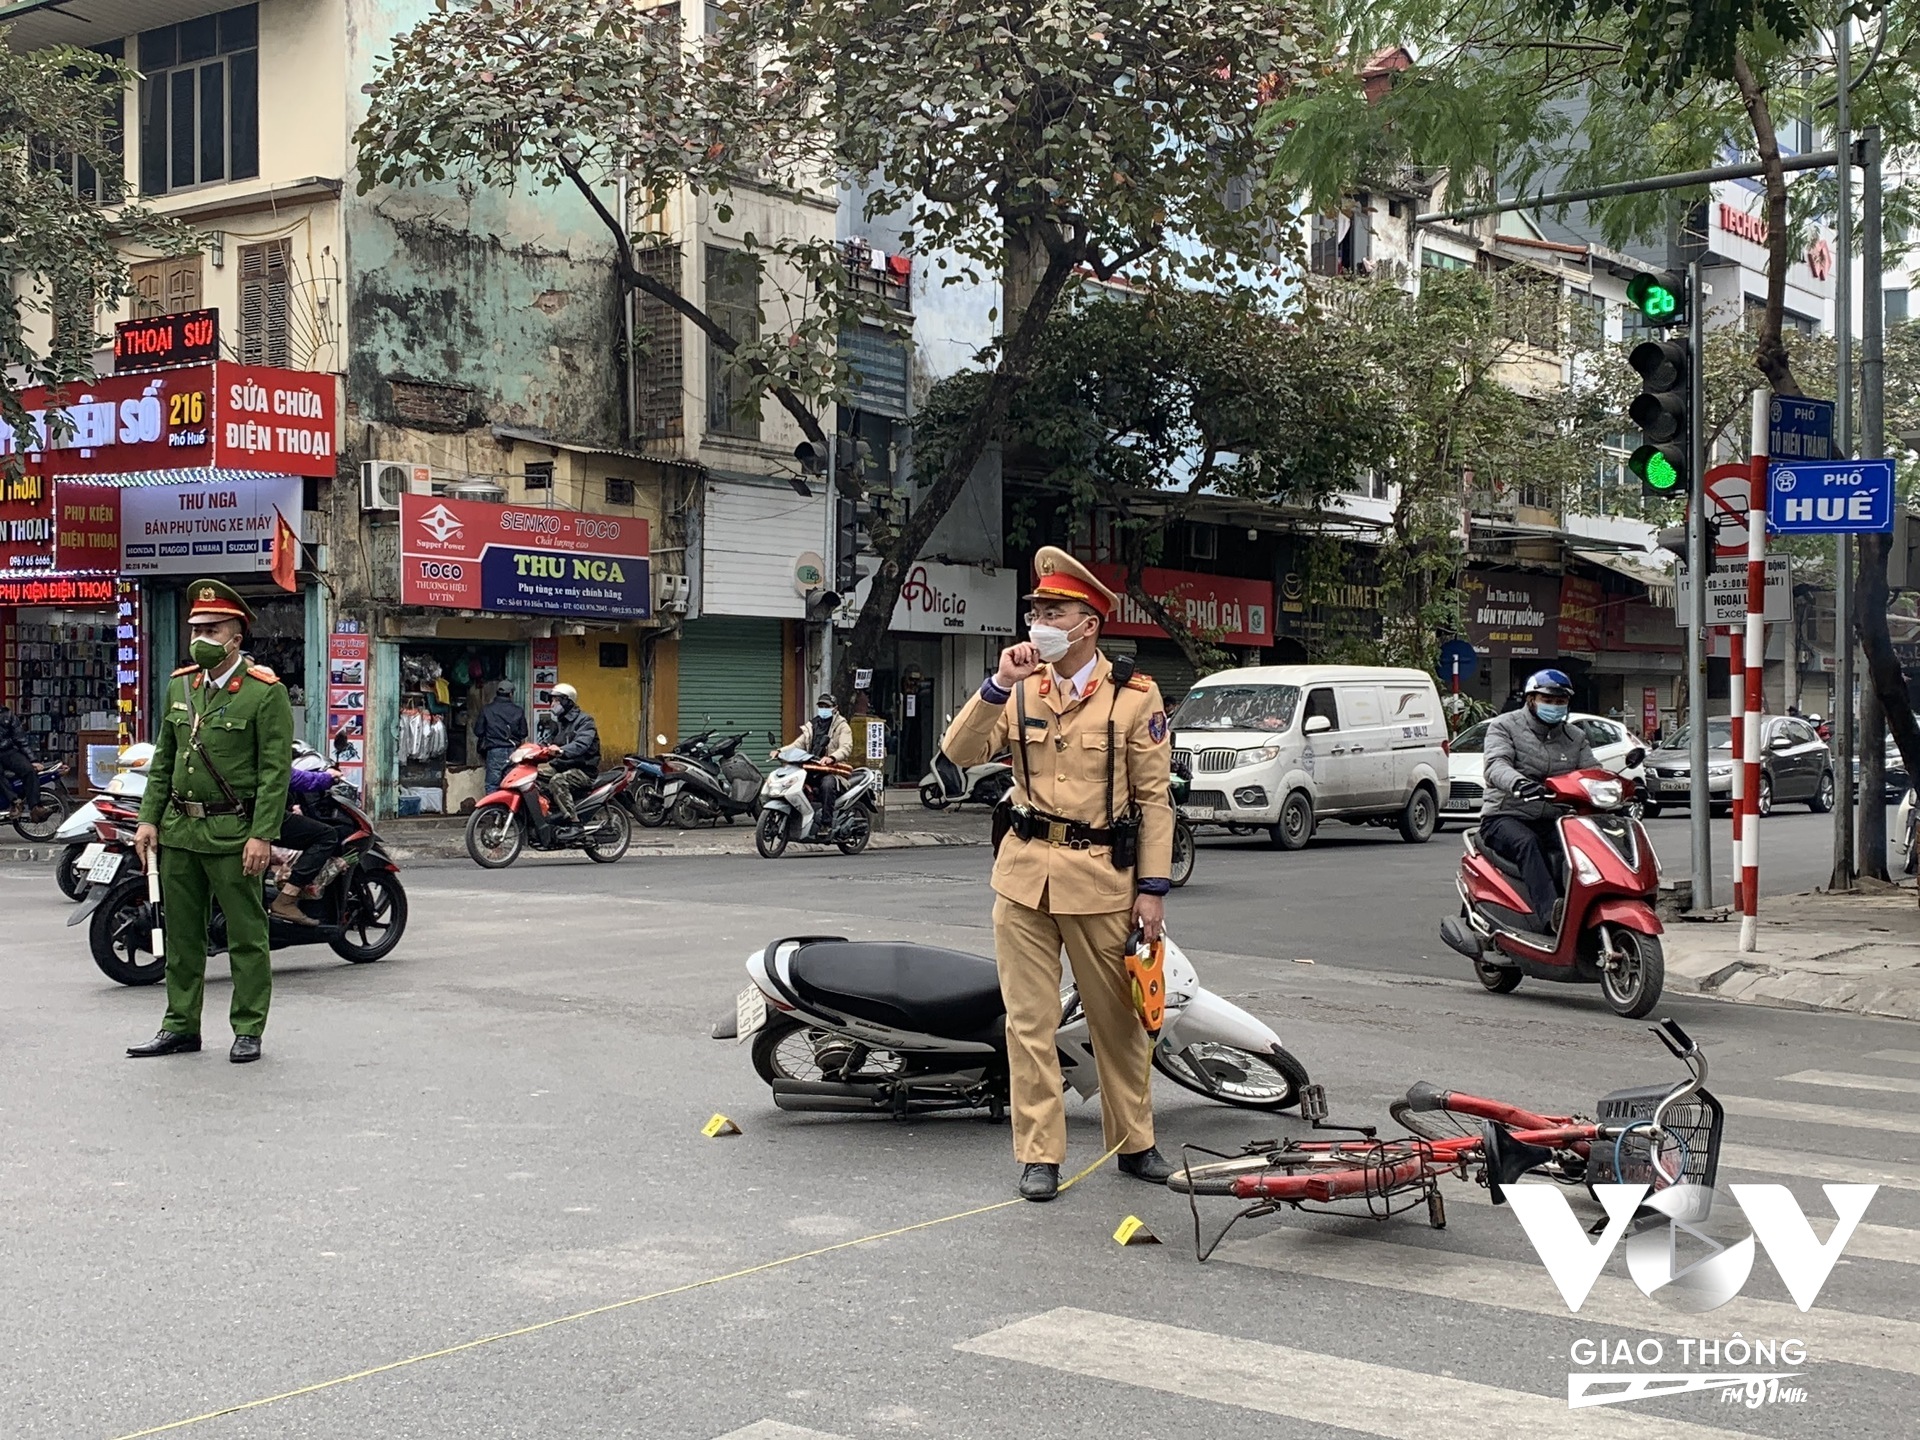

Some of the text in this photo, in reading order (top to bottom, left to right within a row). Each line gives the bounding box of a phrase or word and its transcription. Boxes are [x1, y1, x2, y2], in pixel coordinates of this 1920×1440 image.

[1720, 204, 1768, 244] TECHCO
[1646, 286, 1674, 314] 26
[124, 326, 173, 356] THOẠI
[169, 391, 203, 426] 216
[230, 378, 324, 420] SỬA CHỮA
[119, 379, 163, 445] SỐ
[1794, 405, 1816, 421] PHỐ
[168, 428, 207, 447] Phố Huế
[226, 420, 331, 460] ĐIỆN THOẠI
[1782, 426, 1800, 456] HIẾN
[1803, 430, 1828, 459] THÀNH
[1824, 468, 1865, 486] PHỐ
[178, 491, 238, 510] THƯ NGA
[1785, 488, 1880, 522] HUẾ
[64, 504, 114, 524] PHỤ KIỆN
[10, 518, 49, 546] THOẠI
[145, 513, 272, 537] BÁN PHỤ TÙNG XE MÁY
[500, 510, 561, 534] SENKO
[574, 518, 620, 540] TOCO
[60, 530, 118, 550] ĐIỆN THOẠI
[160, 545, 188, 554] PIAGGIO
[194, 544, 220, 553] YAMAHA
[228, 542, 257, 552] SUZUKI
[416, 539, 466, 551] Supper Power
[574, 540, 589, 549] cao
[420, 561, 464, 581] TOCO
[514, 554, 626, 584] THU NGA
[1768, 560, 1786, 572] ĐỘNG
[22, 580, 48, 603] KIỆN
[49, 579, 76, 601] ĐIỆN
[78, 580, 112, 601] THOẠI
[118, 582, 131, 594] 216
[518, 582, 534, 594] Phụ
[536, 584, 554, 596] tùng
[564, 586, 581, 598] máy
[582, 588, 602, 598] chính
[901, 566, 967, 615] Alicia
[1714, 594, 1742, 607] NGOẠI
[1186, 592, 1218, 630] PHỞ
[1222, 598, 1242, 632] GÀ
[1477, 604, 1496, 624] BÚN
[1498, 610, 1516, 630] THỊT
[1717, 608, 1748, 621] Excep
[338, 622, 356, 632] 216
[337, 649, 360, 657] TOCO
[708, 1119, 720, 1132] 2
[1121, 1221, 1135, 1238] 1
